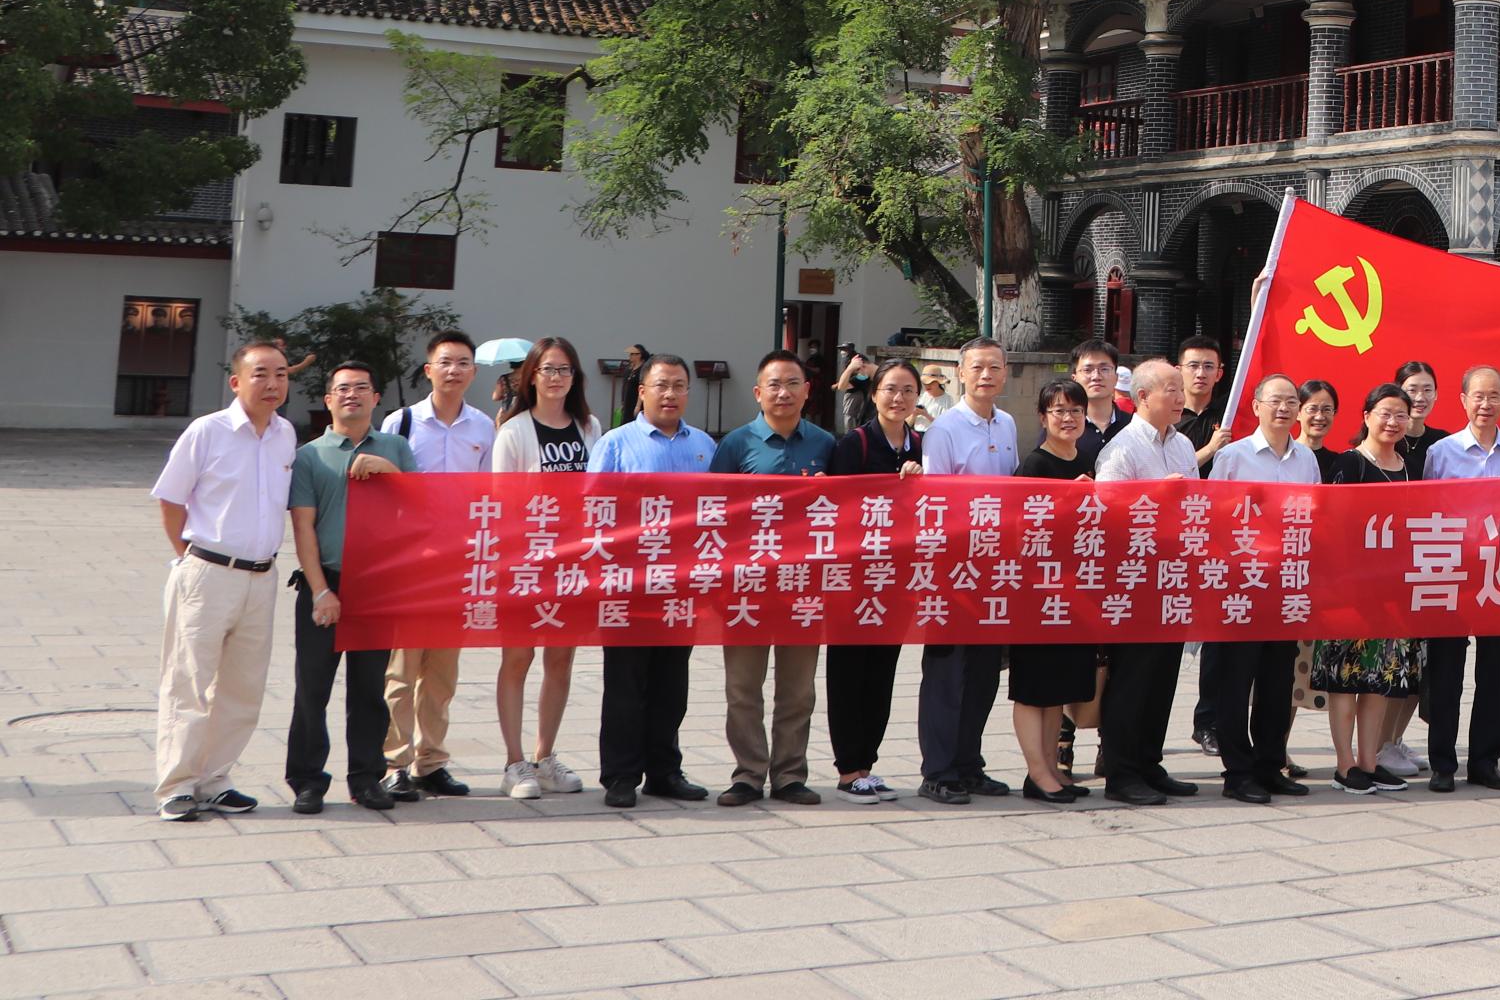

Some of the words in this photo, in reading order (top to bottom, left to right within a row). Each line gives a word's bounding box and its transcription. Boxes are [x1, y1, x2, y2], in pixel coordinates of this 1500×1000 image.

[542, 463, 574, 472] MADE
[469, 494, 1313, 528] 中华预防医学会流行病学分会党小组
[466, 527, 1312, 561] 北京大学公共卫生学院流统系党支部
[462, 560, 1311, 596] 北京协和医学院群医学及公共卫生学院党支部
[462, 594, 1312, 630] 遵义医科大学公共卫生学院党委
